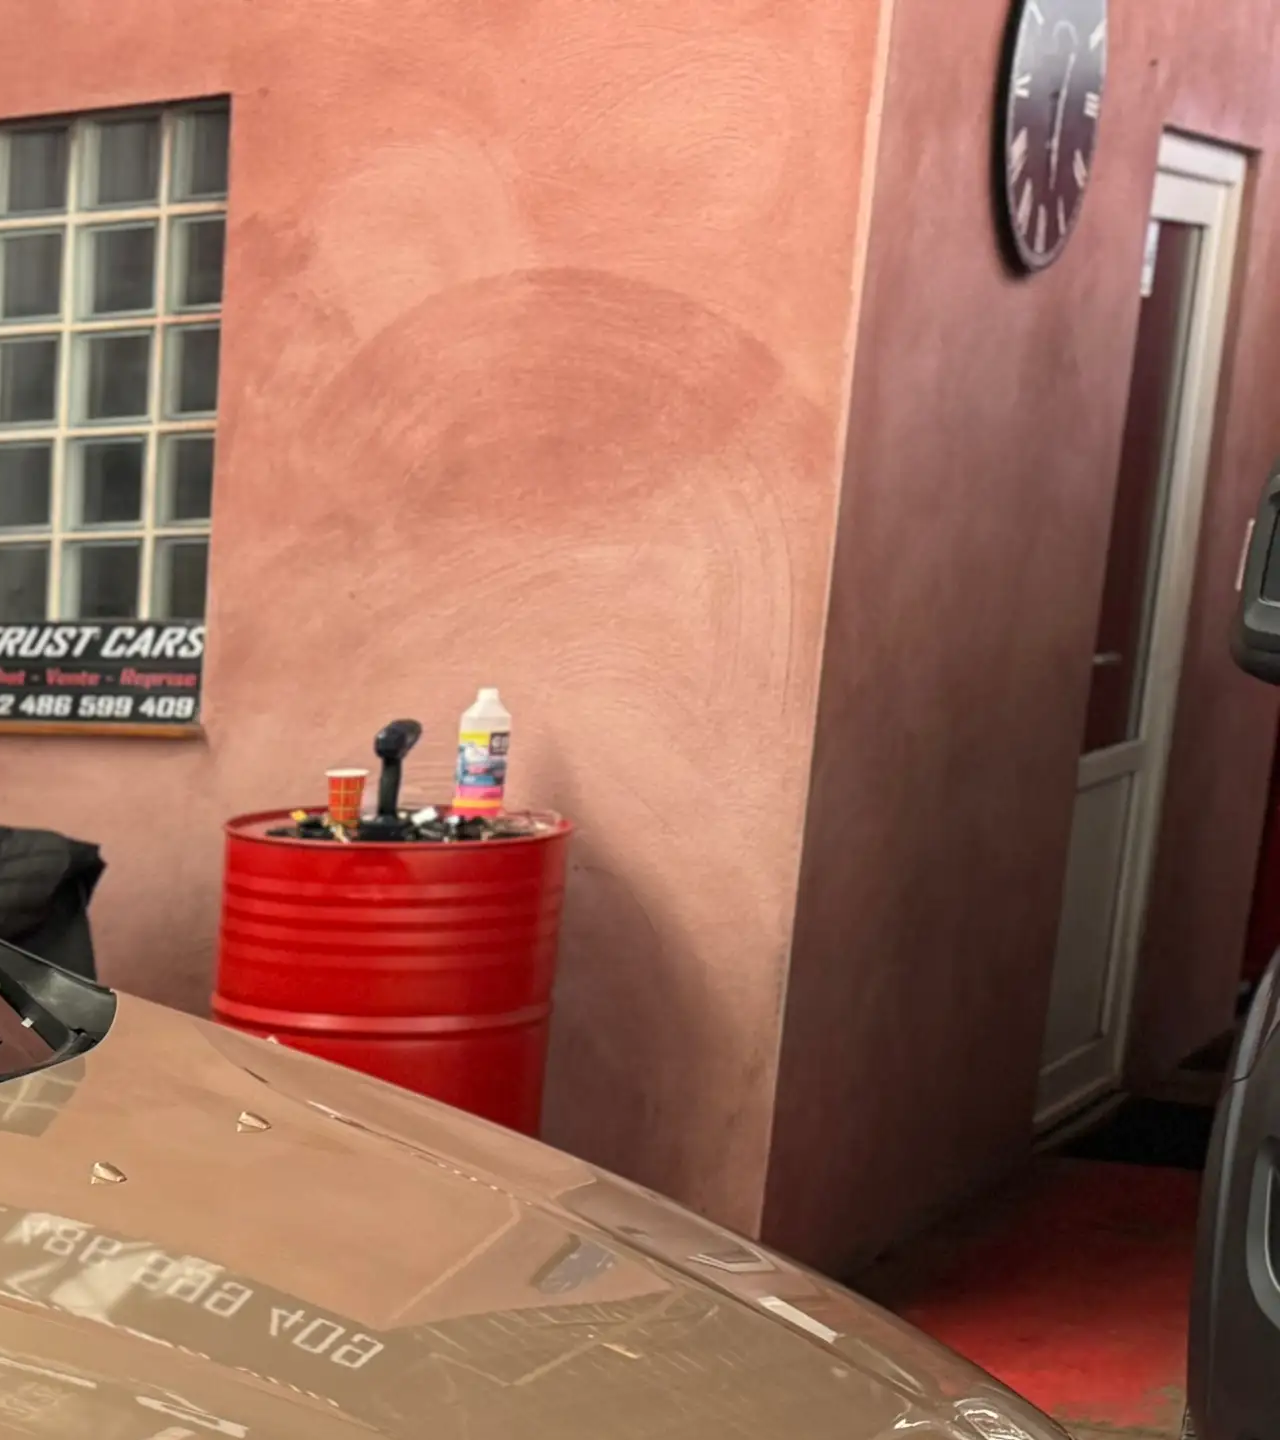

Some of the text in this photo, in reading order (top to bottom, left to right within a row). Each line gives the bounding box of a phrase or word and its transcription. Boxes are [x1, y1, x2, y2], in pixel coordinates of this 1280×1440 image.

[101, 626, 207, 658] CARS
[19, 695, 72, 717] 486
[77, 695, 133, 718] 599
[138, 696, 195, 718] 409
